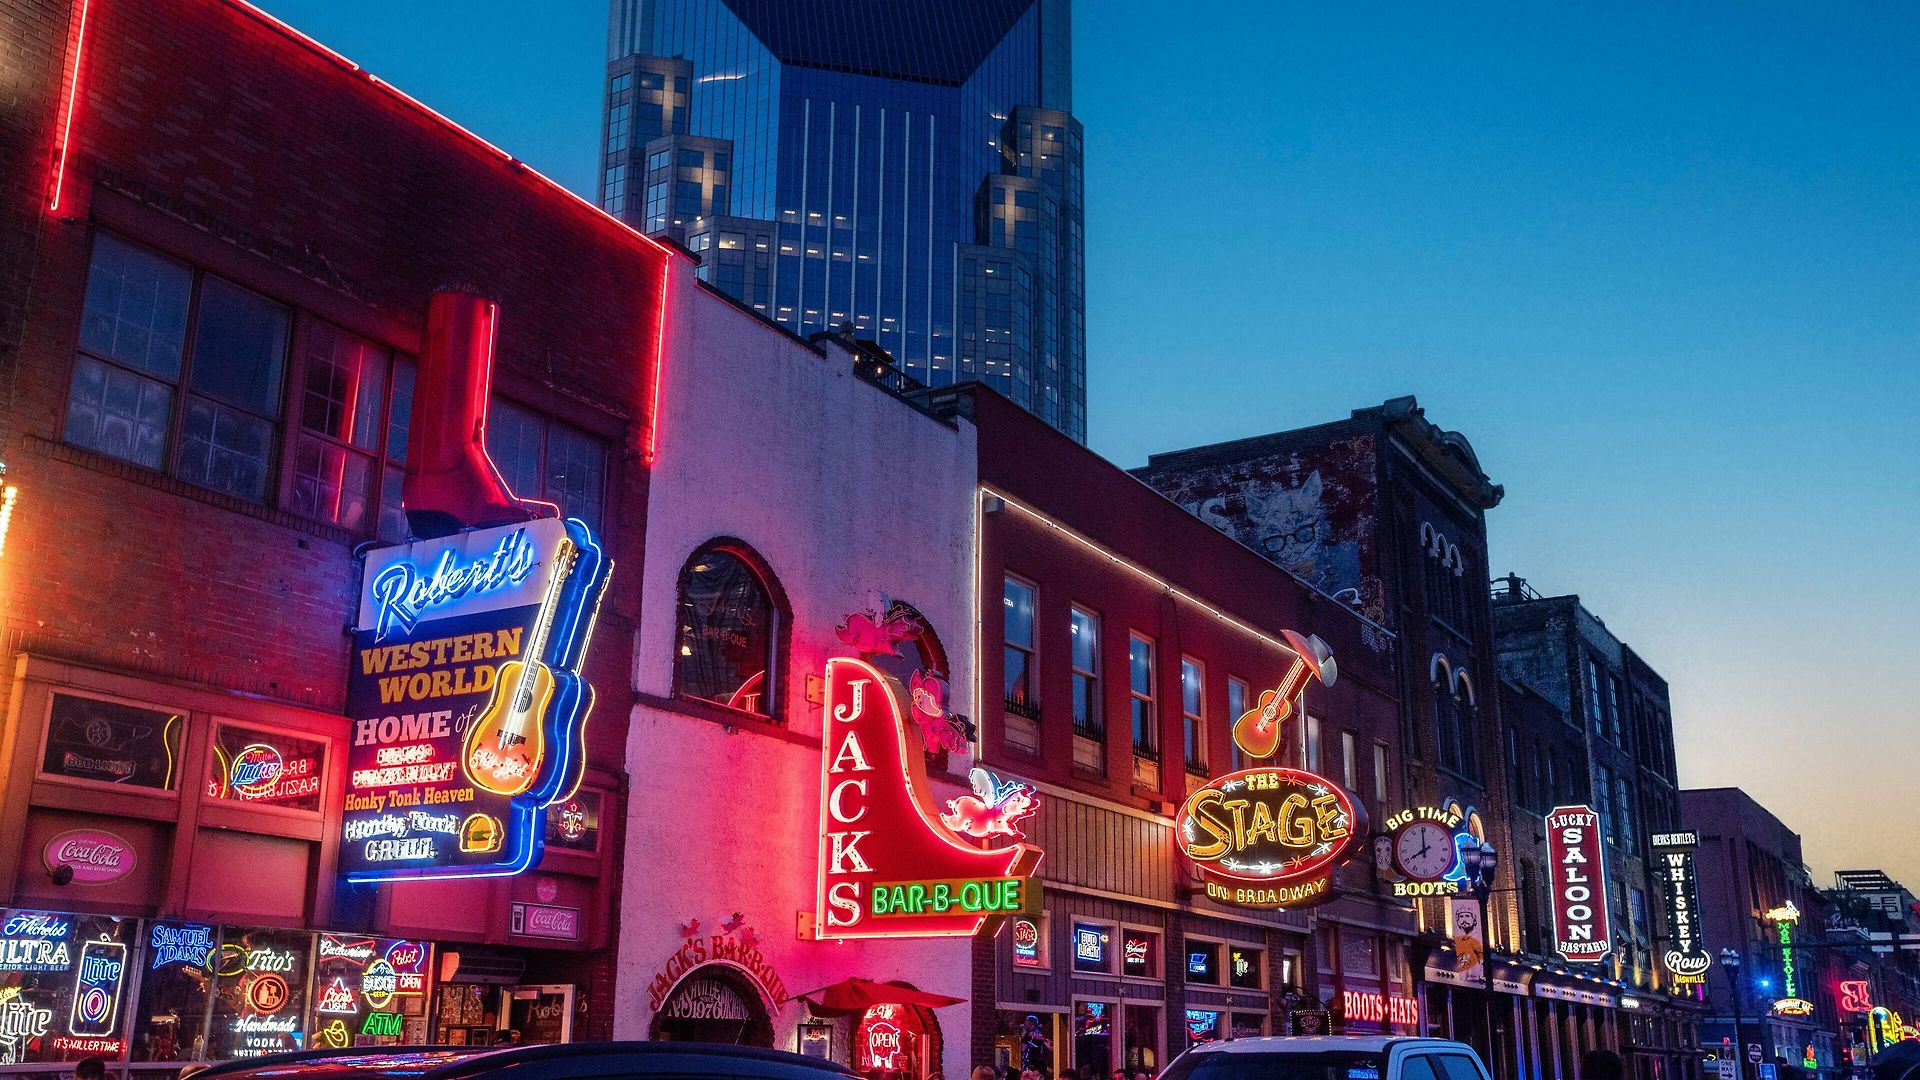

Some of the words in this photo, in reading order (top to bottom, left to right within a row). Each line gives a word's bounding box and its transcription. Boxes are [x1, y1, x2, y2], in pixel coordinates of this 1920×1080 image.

[373, 527, 534, 644] Robert's
[361, 626, 523, 676] WESTERN
[378, 664, 497, 705] WORLD
[355, 710, 453, 746] HOME
[455, 704, 477, 741] of
[1245, 773, 1280, 791] THE
[344, 791, 387, 813] Honky
[389, 787, 421, 808] Tonk
[424, 786, 474, 805] Heaven
[827, 679, 876, 927] JACKS
[1187, 788, 1349, 861] STAGE
[1386, 809, 1414, 831] BIG
[1417, 806, 1460, 829] TIME
[1550, 813, 1594, 829] LUCKY
[57, 840, 124, 867] Coca-Cola
[1207, 882, 1228, 900] ON
[1236, 878, 1326, 904] BROADWAY
[1393, 881, 1459, 896] BOOTS
[1562, 828, 1592, 940] SALOON
[872, 880, 1020, 914] BAR-B-QUE
[1667, 853, 1691, 953] WHISKEY
[4, 916, 67, 937] Michelob
[530, 908, 574, 931] Coca-Cola
[152, 925, 213, 948] SAMUEL
[1081, 933, 1097, 945] BUD
[1560, 940, 1608, 954] BASTARD
[153, 946, 206, 969] ADAMS
[247, 947, 294, 971] Tito's
[391, 948, 418, 966] Pabst
[1079, 944, 1100, 958] LIGHT
[1668, 952, 1707, 973] Row
[25, 963, 48, 971] LIGHT
[81, 956, 121, 985] Lite
[647, 938, 707, 1011] JACK'S
[1675, 973, 1705, 984] NASHVILLE
[363, 975, 396, 991] BUSCH
[400, 974, 421, 989] OPEN
[692, 999, 721, 1019] 1976
[1344, 991, 1383, 1023] BOOTS
[1389, 997, 1419, 1025] HATS
[234, 1015, 296, 1032] Handmade
[361, 1012, 403, 1036] ATM
[53, 1037, 68, 1049] IT'S
[247, 1038, 283, 1048] VODKA
[872, 1033, 896, 1047] OPEN
